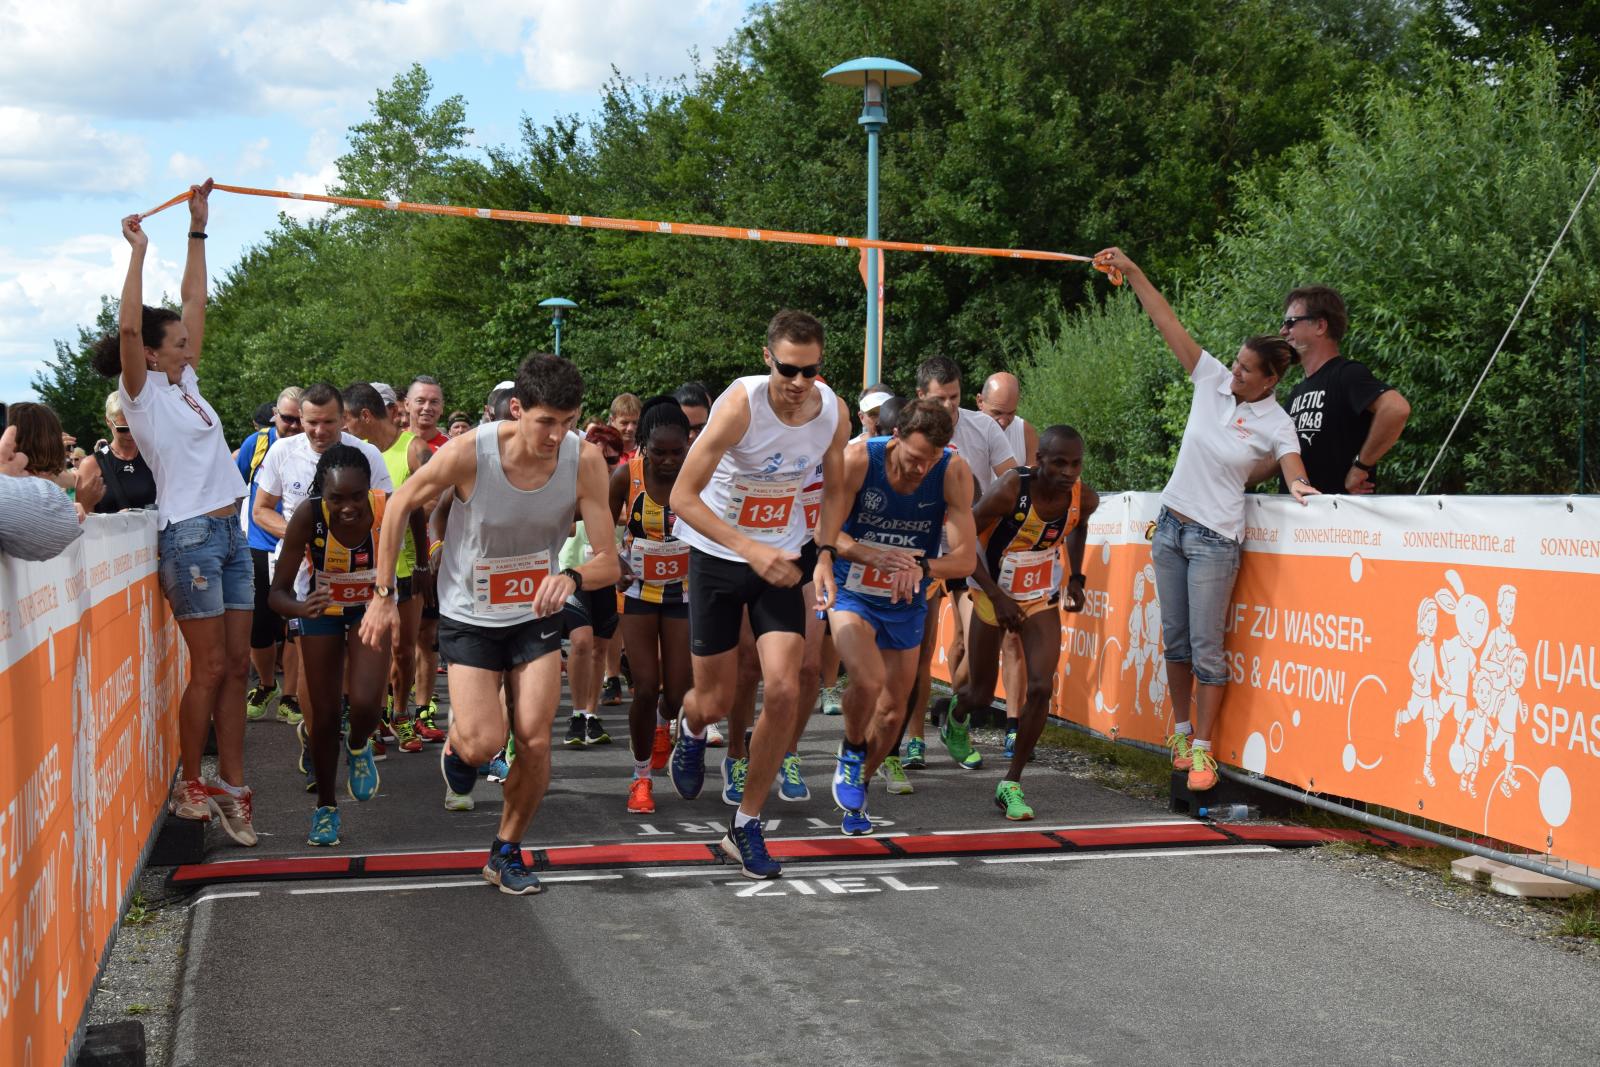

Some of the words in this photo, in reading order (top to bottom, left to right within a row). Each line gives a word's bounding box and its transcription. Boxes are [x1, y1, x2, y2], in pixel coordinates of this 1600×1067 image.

[1298, 411, 1323, 429] 1948
[749, 503, 786, 523] 134
[877, 532, 918, 547] TDK
[655, 560, 679, 576] 83
[504, 577, 534, 597] 20
[1023, 569, 1041, 588] 81
[343, 587, 370, 599] 84
[1250, 605, 1278, 640] ZU
[1284, 609, 1372, 653] WASSER-
[1250, 655, 1262, 689] &
[1267, 659, 1346, 705] ACTION!
[9, 791, 23, 879] ZU
[725, 875, 940, 898] ZIEL
[22, 849, 56, 982] ACTION!
